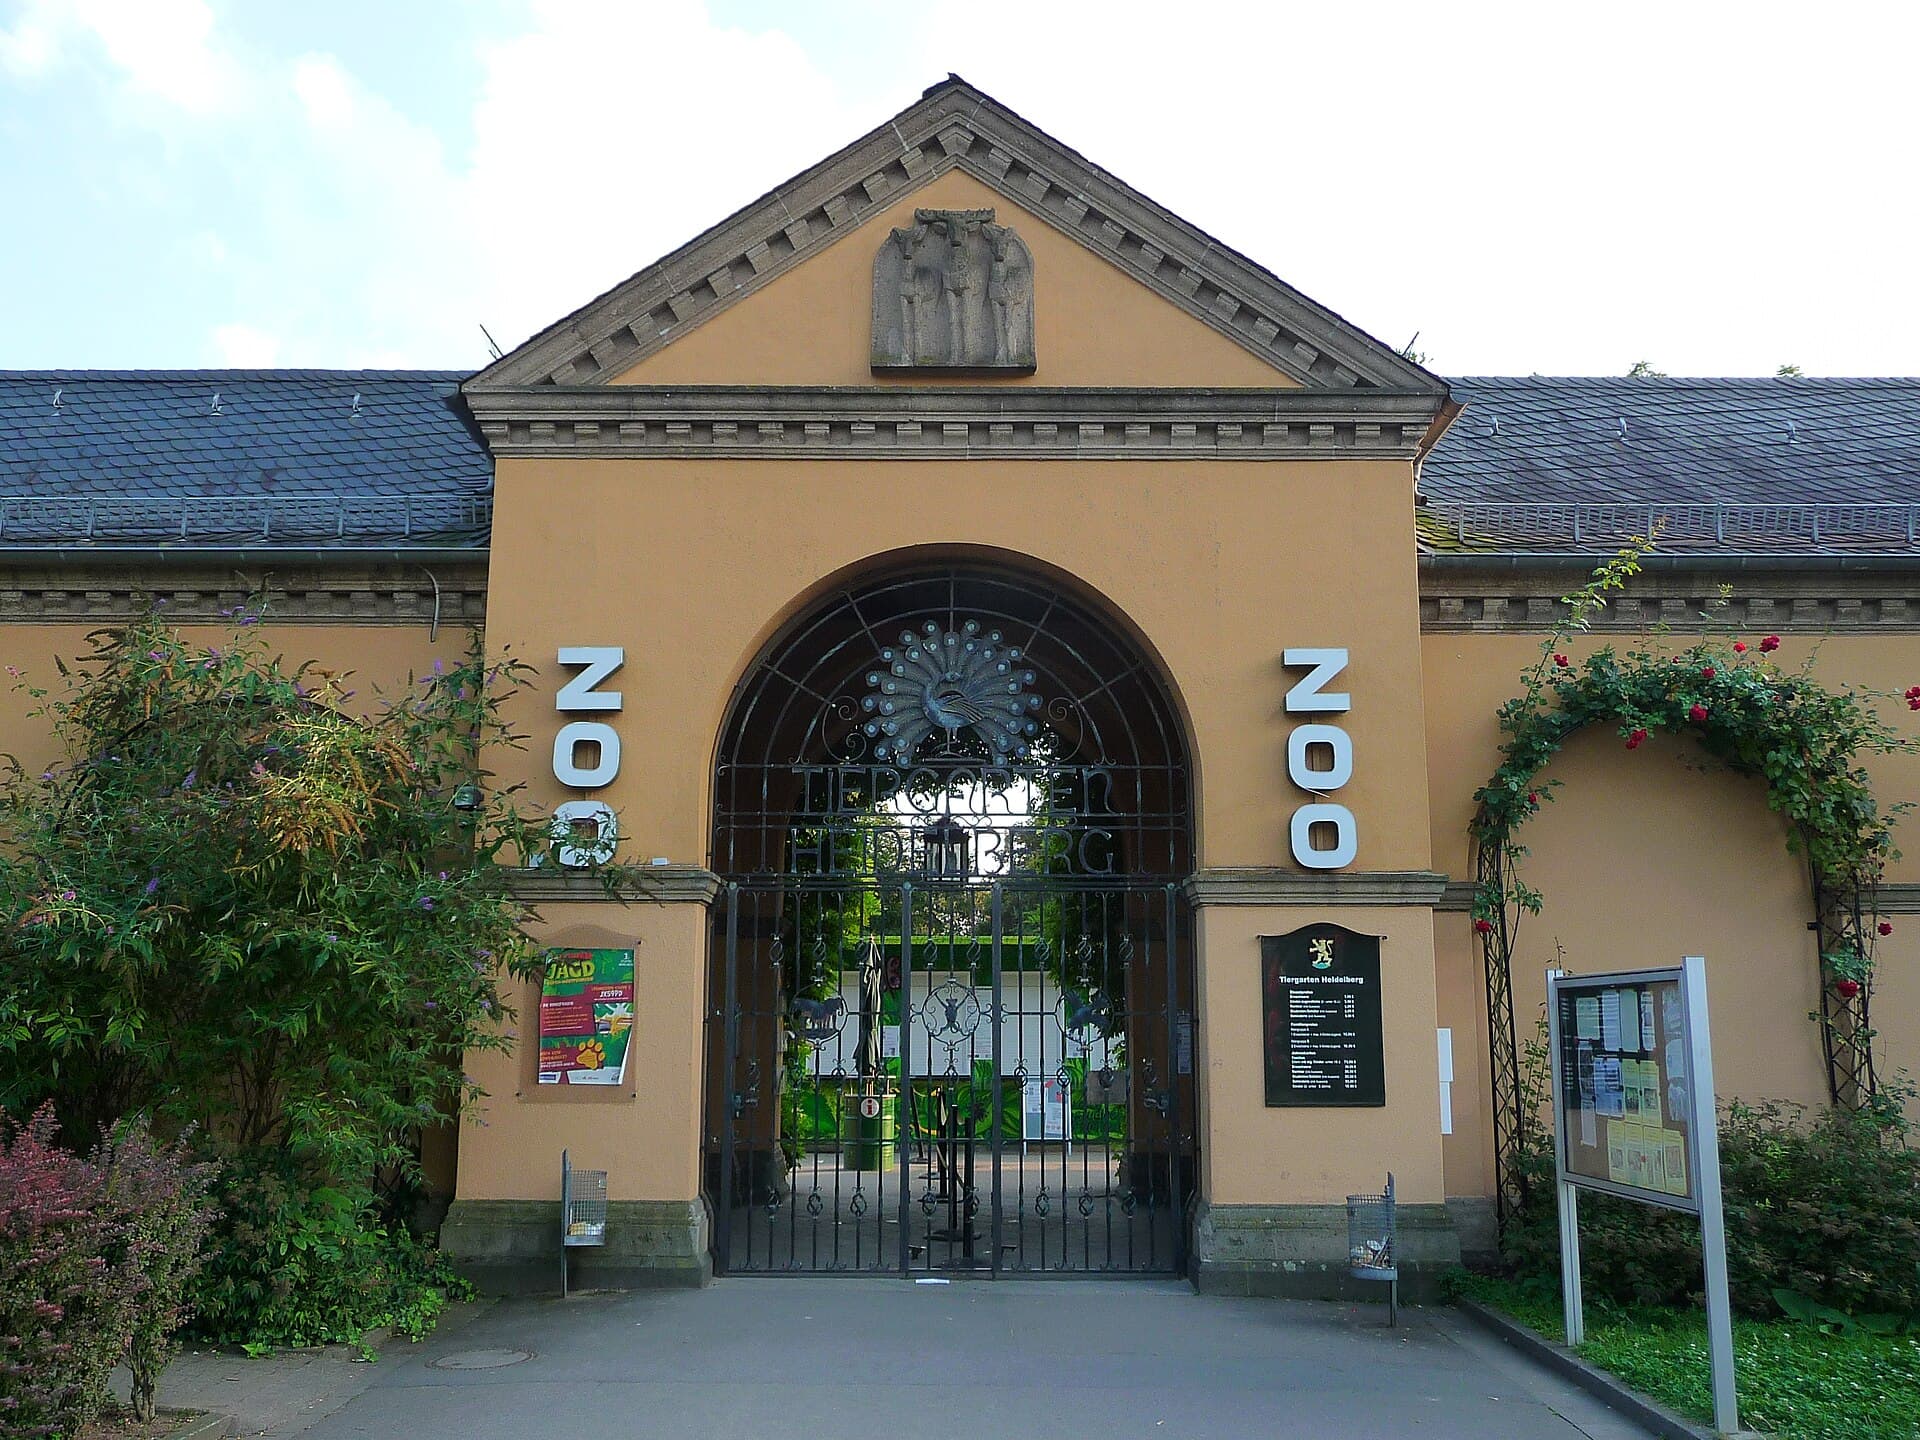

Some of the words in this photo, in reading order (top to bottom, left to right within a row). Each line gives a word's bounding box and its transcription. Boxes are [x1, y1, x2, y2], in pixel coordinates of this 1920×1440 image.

[550, 647, 624, 867] ZOO
[1283, 648, 1358, 869] ZOO
[791, 767, 1118, 815] TIERGARTEN
[791, 828, 1114, 875] HEIDELBERG
[1279, 976, 1320, 985] Tiergarten
[1321, 976, 1364, 985] Heidelberg
